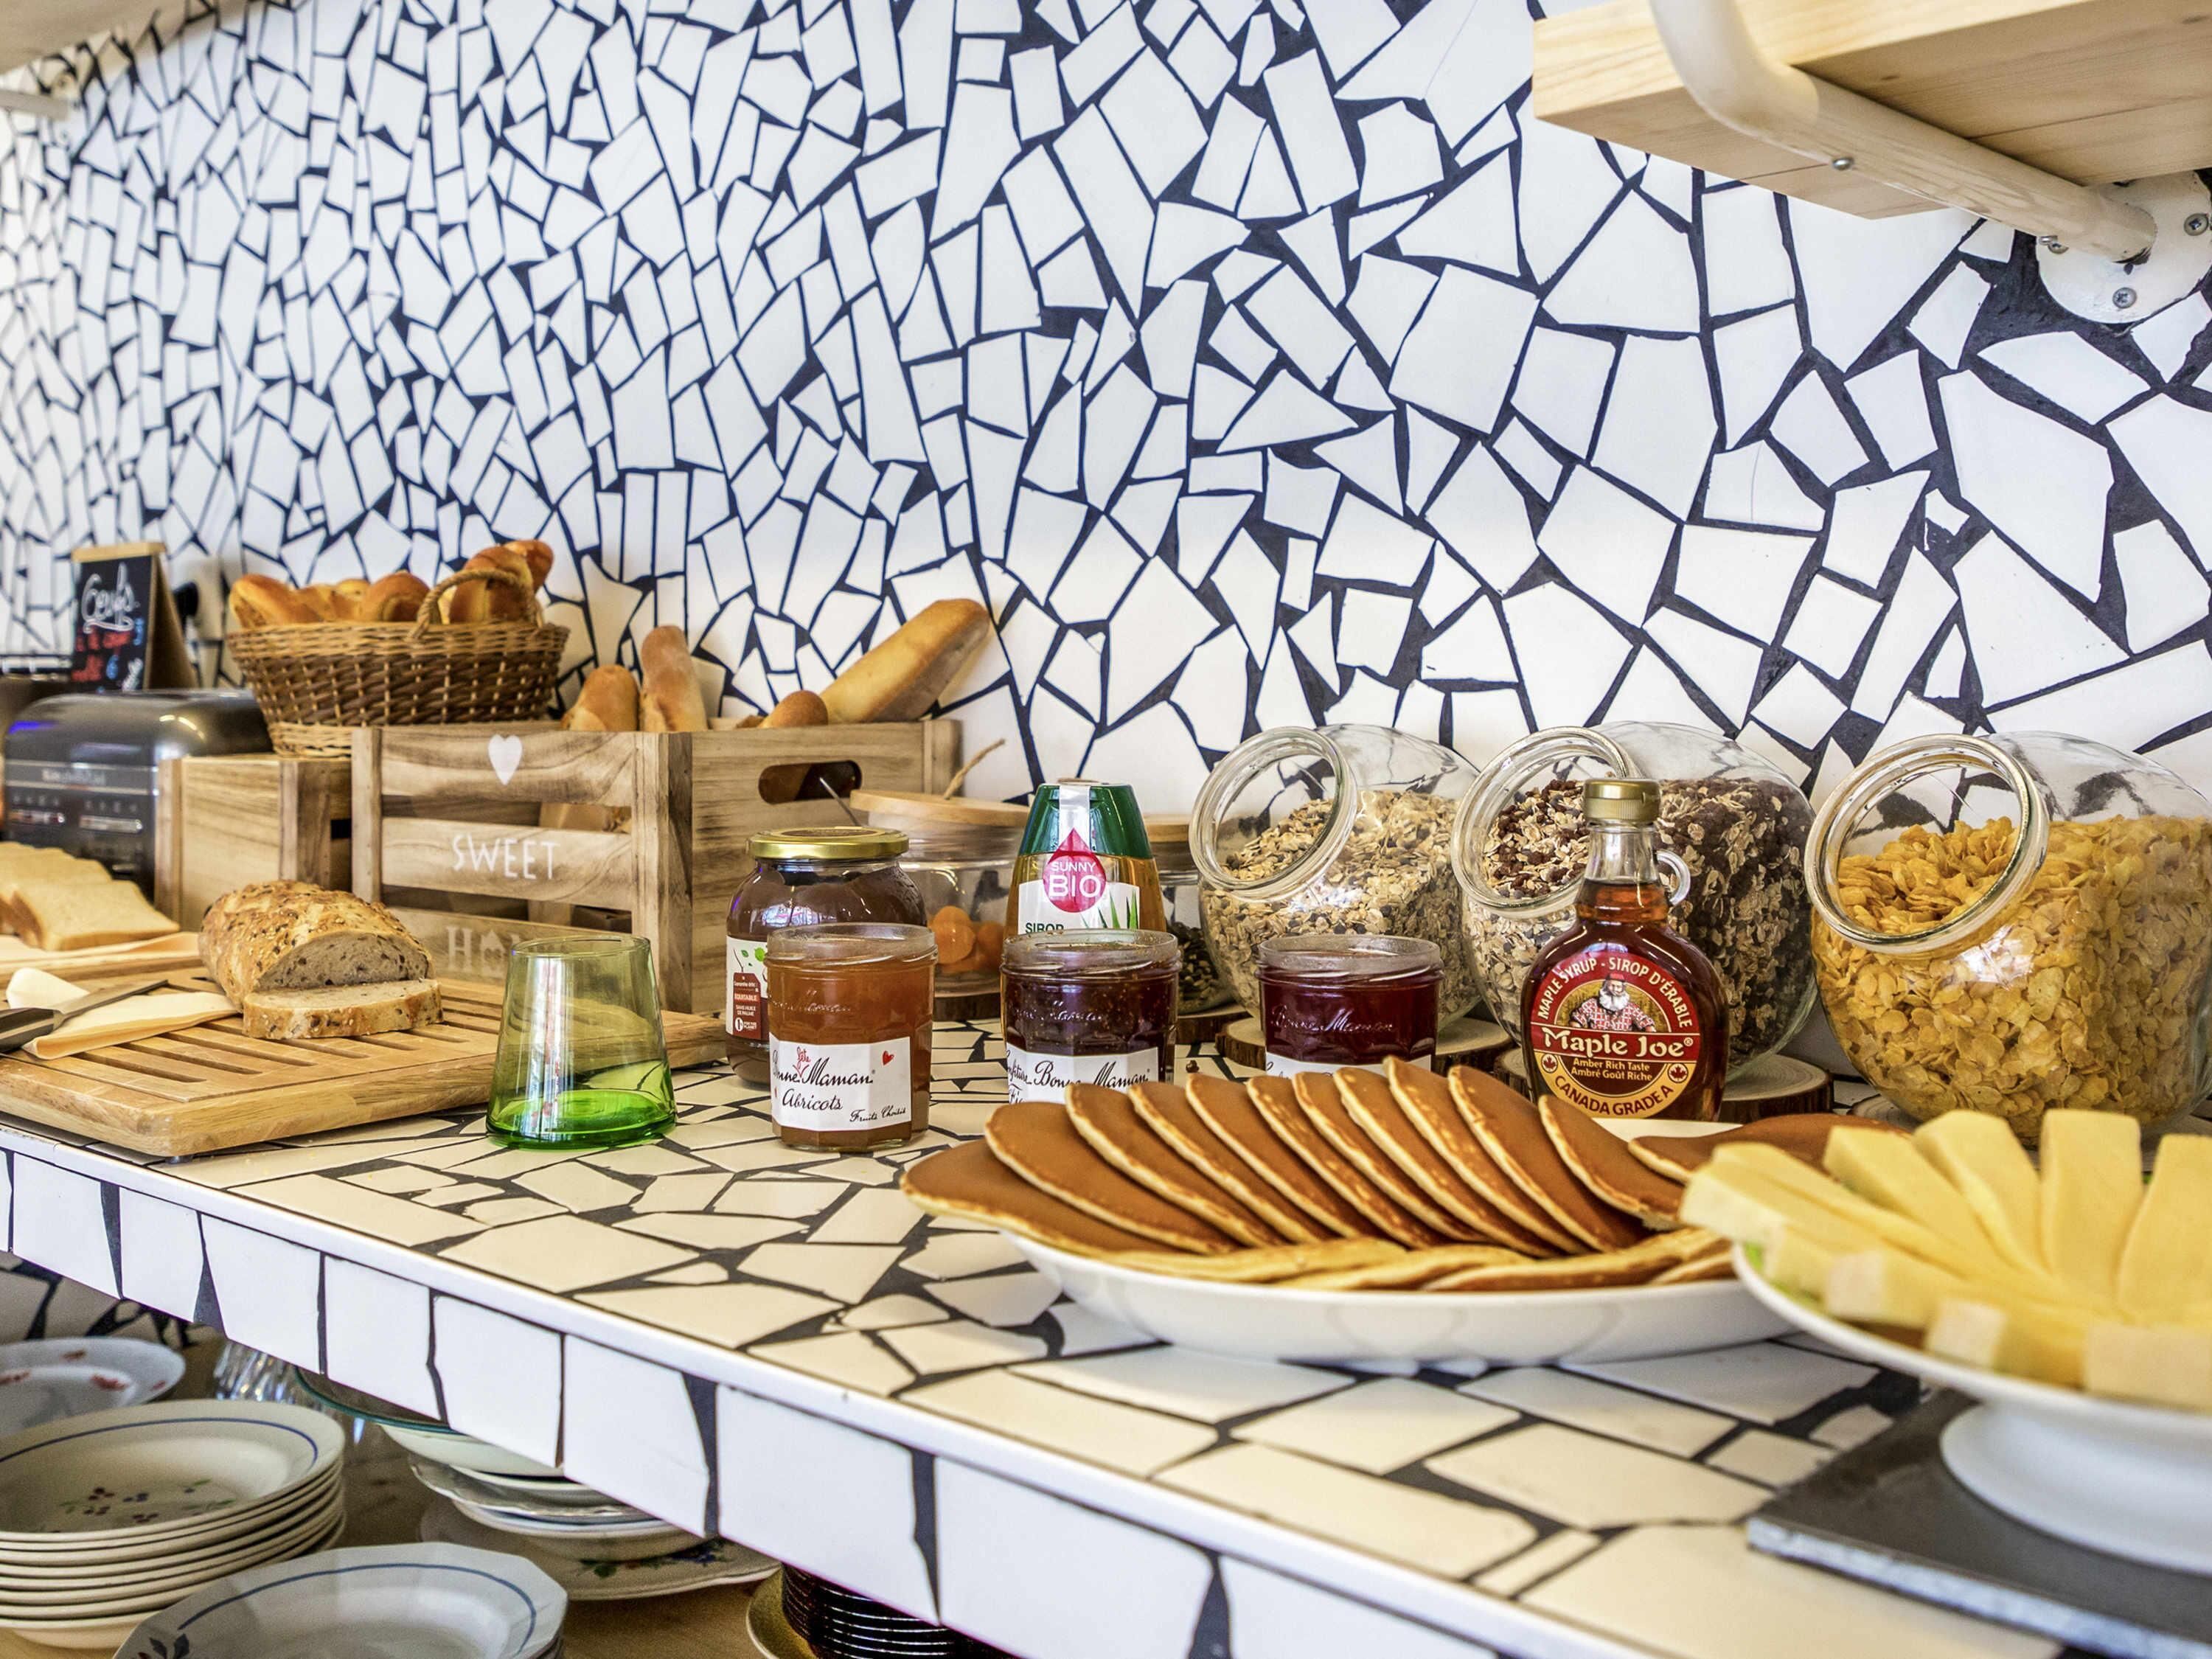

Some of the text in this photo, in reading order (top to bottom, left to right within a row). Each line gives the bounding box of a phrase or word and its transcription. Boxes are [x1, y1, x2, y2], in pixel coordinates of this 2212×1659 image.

[452, 833, 560, 880] SWEET
[1051, 861, 1096, 872] SUNNY
[1049, 874, 1101, 897] BIO
[1537, 979, 1563, 1020] MAPLE
[1559, 958, 1597, 984] SYRUP
[1608, 956, 1649, 978] SIROP
[1649, 972, 1693, 1029] D'ÉRABLE
[1542, 1027, 1628, 1058] Maple
[1571, 1067, 1652, 1082] Ambré Goût Riche
[1573, 1057, 1650, 1071] Amber Rich Taste
[782, 1088, 844, 1111] Abricots
[1554, 1075, 1674, 1116] CANADA GRADE A
[849, 1108, 878, 1123] Fruits
